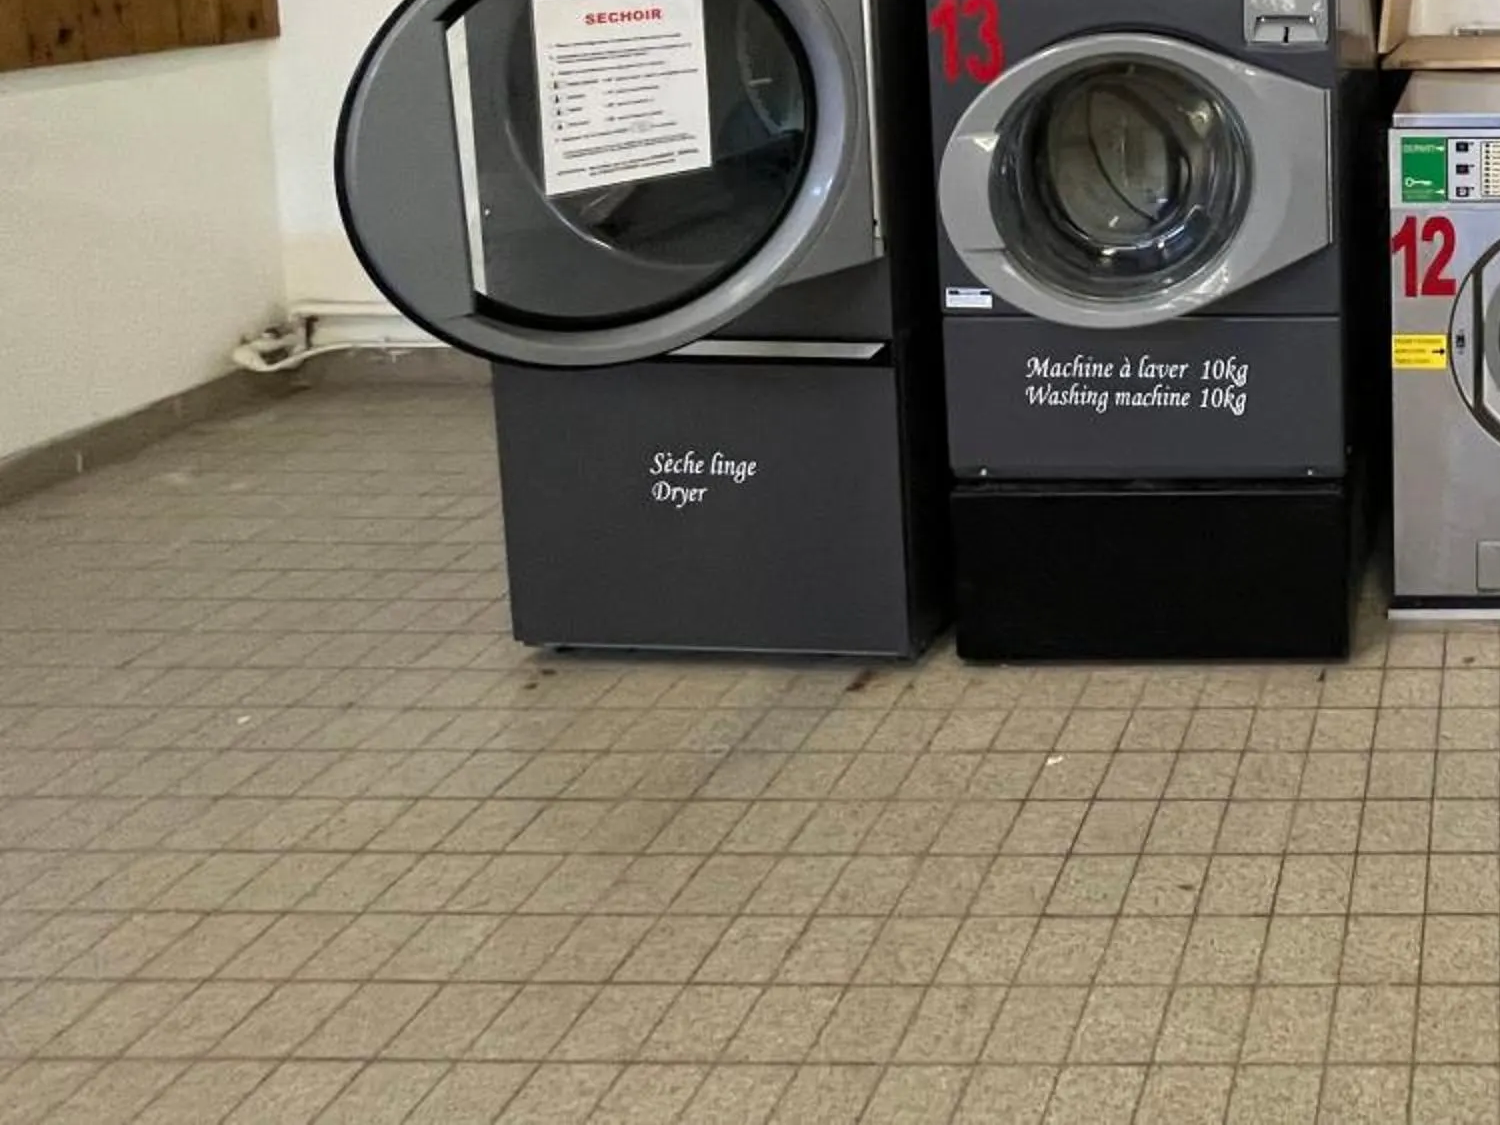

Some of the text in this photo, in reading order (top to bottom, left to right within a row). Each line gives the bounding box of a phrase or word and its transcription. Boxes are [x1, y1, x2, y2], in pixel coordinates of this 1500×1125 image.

[585, 8, 662, 25] SECHOIR
[1391, 216, 1456, 297] 12
[1025, 354, 1249, 387] Machine à laver 10kg
[1025, 383, 1248, 416] Washing machine 10kg
[650, 450, 758, 483] Sèche linge
[651, 480, 708, 508] Dryer
